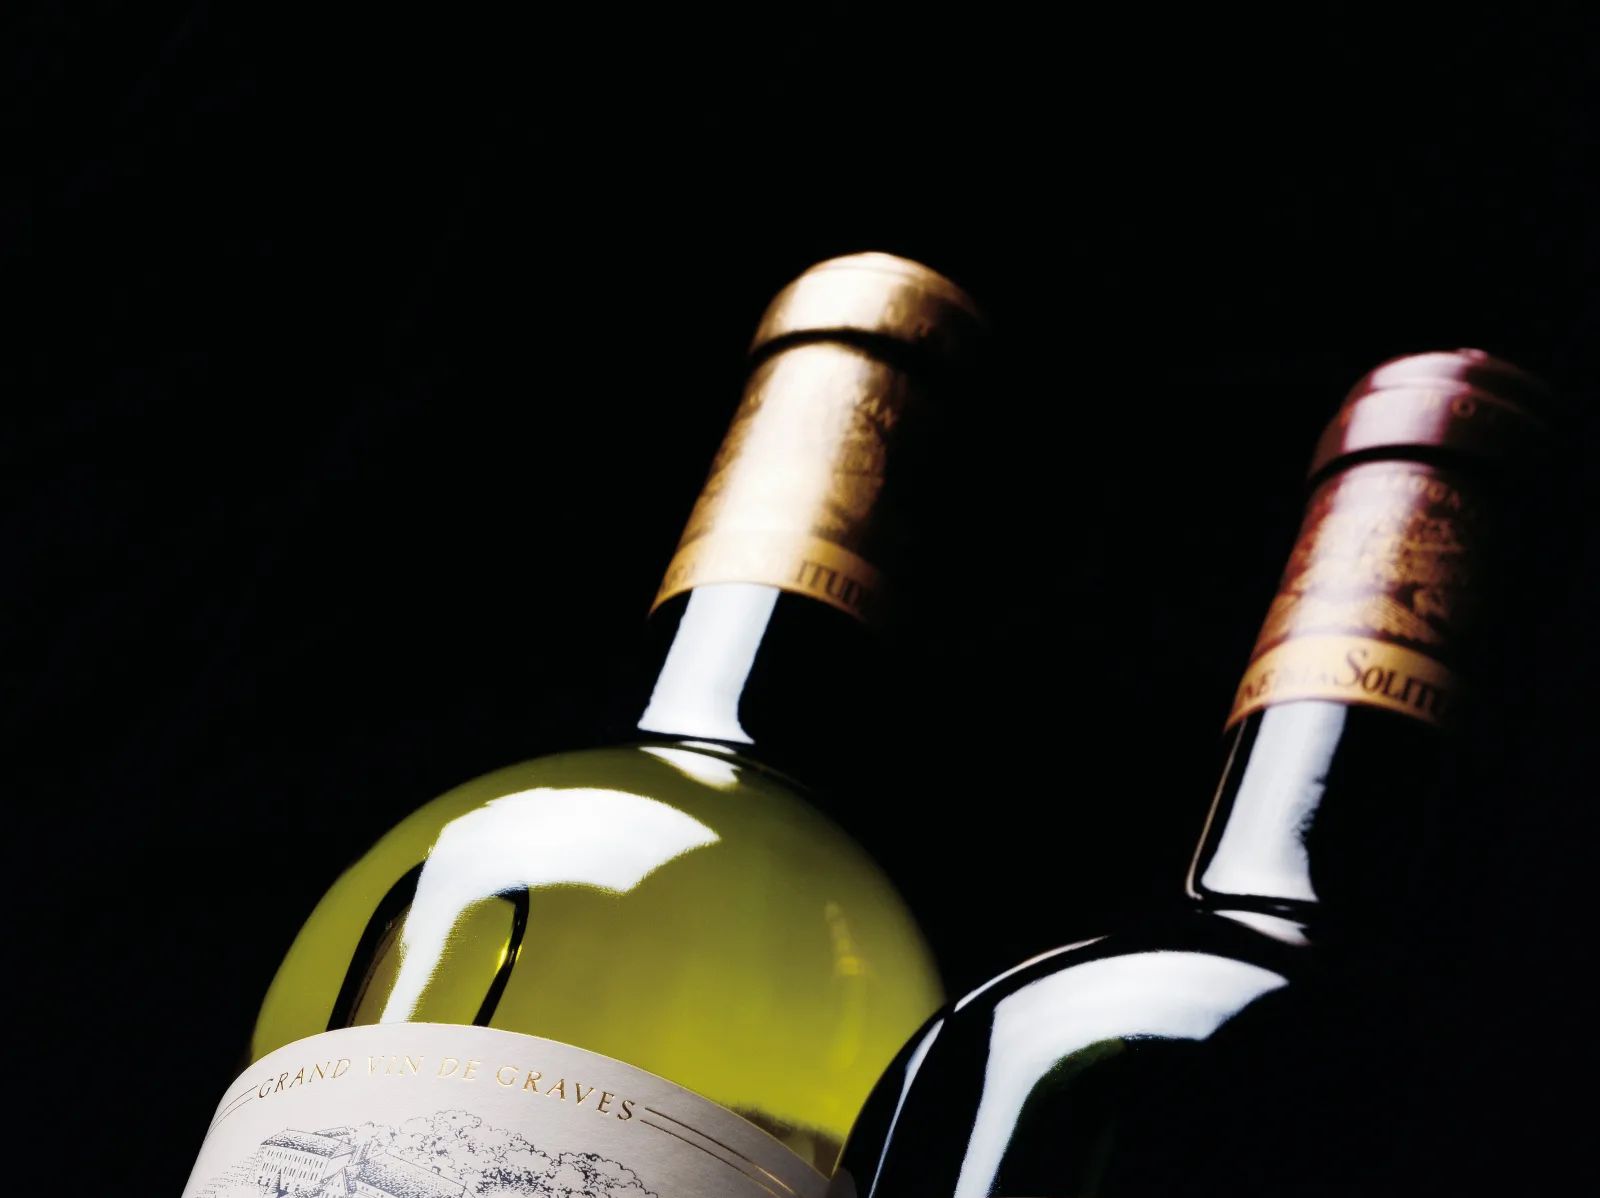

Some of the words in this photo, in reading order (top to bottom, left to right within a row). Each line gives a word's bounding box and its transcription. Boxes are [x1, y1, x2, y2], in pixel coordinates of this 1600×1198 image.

[258, 1058, 351, 1099] GRAND
[367, 1055, 425, 1077] VIN
[437, 1057, 482, 1081] DE
[496, 1065, 636, 1122] GRAVES
